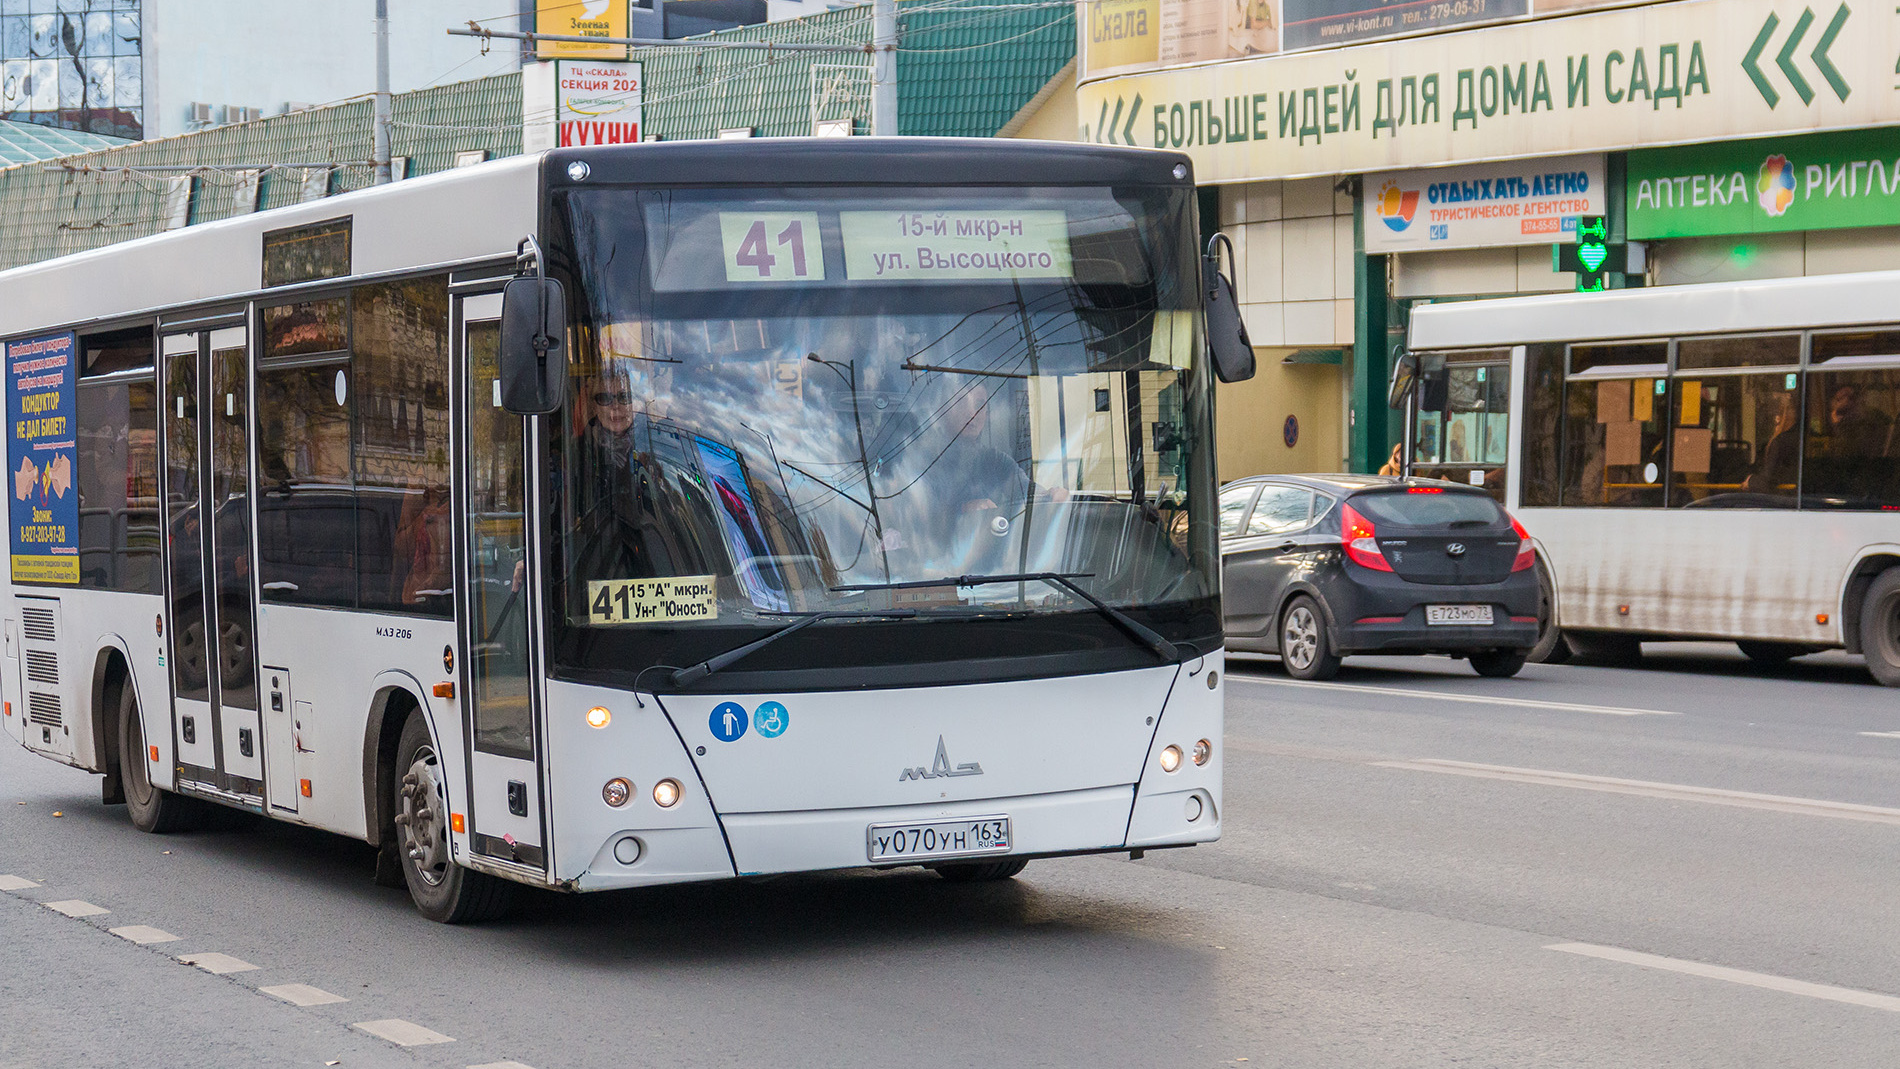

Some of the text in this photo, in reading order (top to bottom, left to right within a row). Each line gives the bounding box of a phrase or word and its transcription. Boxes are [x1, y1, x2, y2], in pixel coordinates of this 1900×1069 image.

[1093, 1, 1148, 43] Скала
[1321, 0, 1486, 37] www.vi-kont.ru тел.: 279-05-31
[561, 79, 638, 92] СЕКЦИЯ 202
[571, 67, 583, 77] ТЦ
[1154, 40, 1711, 148] БОЛЬШЕ ИДЕЙ ДЛЯ ДОМА И САДА
[561, 120, 639, 147] КУХНИ
[1428, 171, 1590, 204] ОТДЫХАТЬ ЛЕГКО
[1636, 172, 1749, 210] АПТЕКА
[1430, 199, 1590, 222] ТУРИСТИЧЕСКОЕ АГЕНТСТВО
[897, 213, 1023, 241] 15-й мкр-н
[735, 219, 808, 277] 41
[873, 247, 1052, 275] ул. Высоцкого
[22, 391, 60, 415] КОНДУКТОР
[16, 416, 66, 441] НЕ ДАЛ БИЛЕТ?
[592, 585, 630, 621] 41
[629, 583, 712, 599] 15 "А" мкрн.
[635, 599, 712, 618] Ун-г "Юность"
[396, 628, 412, 639] 206
[878, 822, 1002, 855] У070УН 163
[978, 840, 995, 848] RUS
